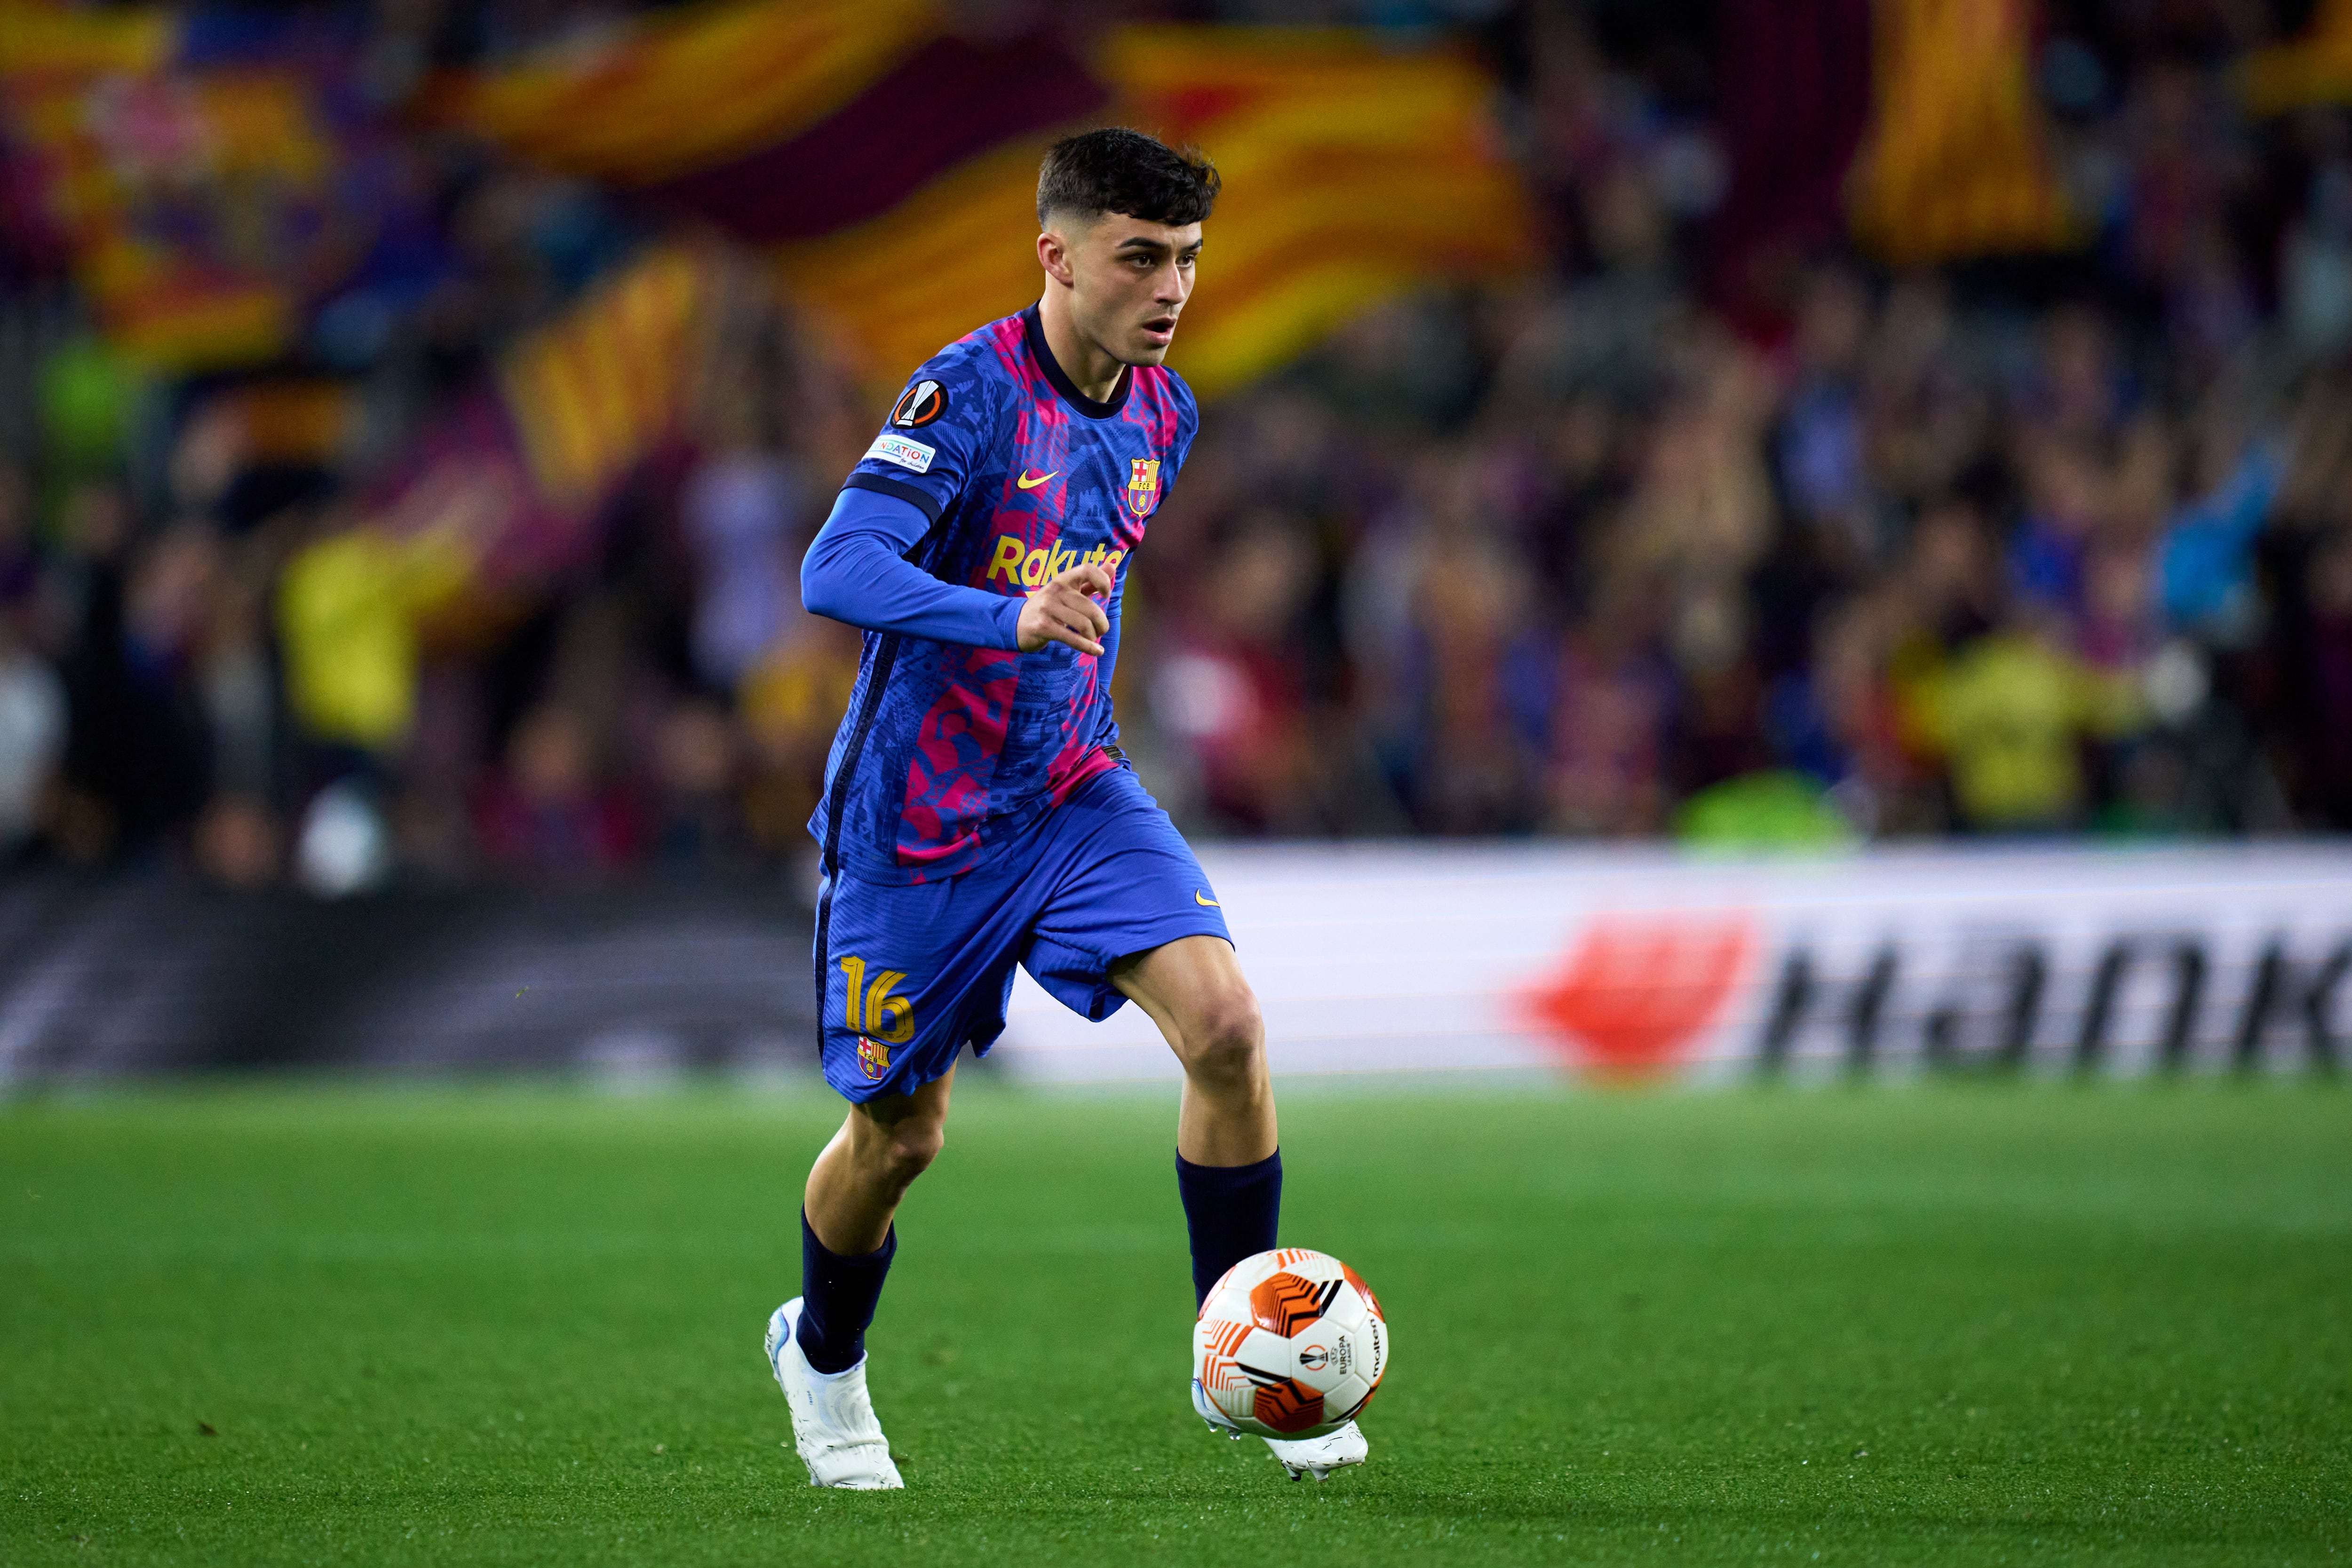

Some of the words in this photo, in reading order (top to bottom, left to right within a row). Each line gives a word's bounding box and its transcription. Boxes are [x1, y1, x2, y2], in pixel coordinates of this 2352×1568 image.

[875, 442, 930, 464] NDATION
[986, 535, 1130, 586] Rakute
[841, 956, 915, 1044] 16
[865, 1053, 877, 1063] FCB
[1370, 1319, 1381, 1377] molten
